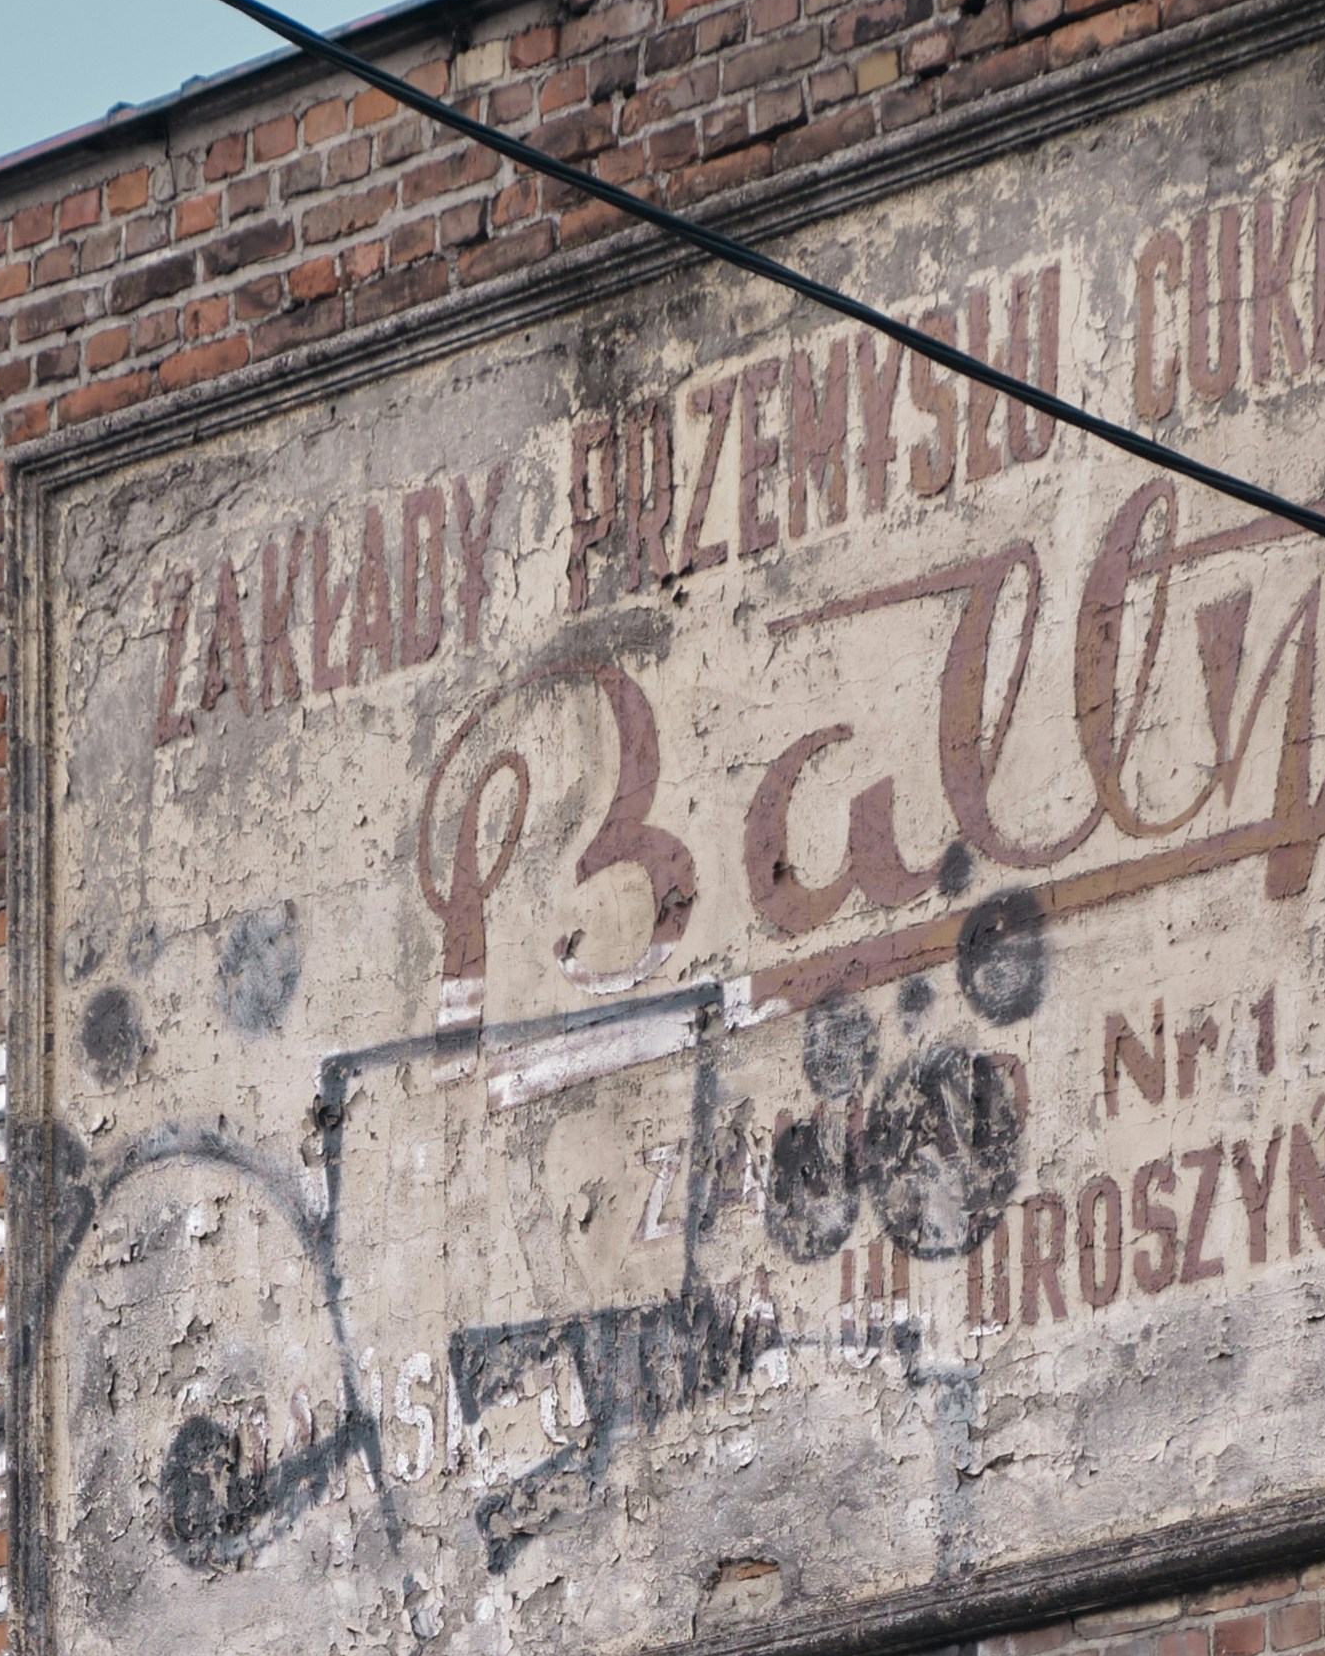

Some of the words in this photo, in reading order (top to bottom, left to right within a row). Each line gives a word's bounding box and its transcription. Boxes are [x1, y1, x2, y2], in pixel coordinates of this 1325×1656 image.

[152, 459, 508, 747] ZAKŁADY
[568, 263, 1060, 613] PRZEMYSŁU
[1103, 996, 1219, 1121] Nr
